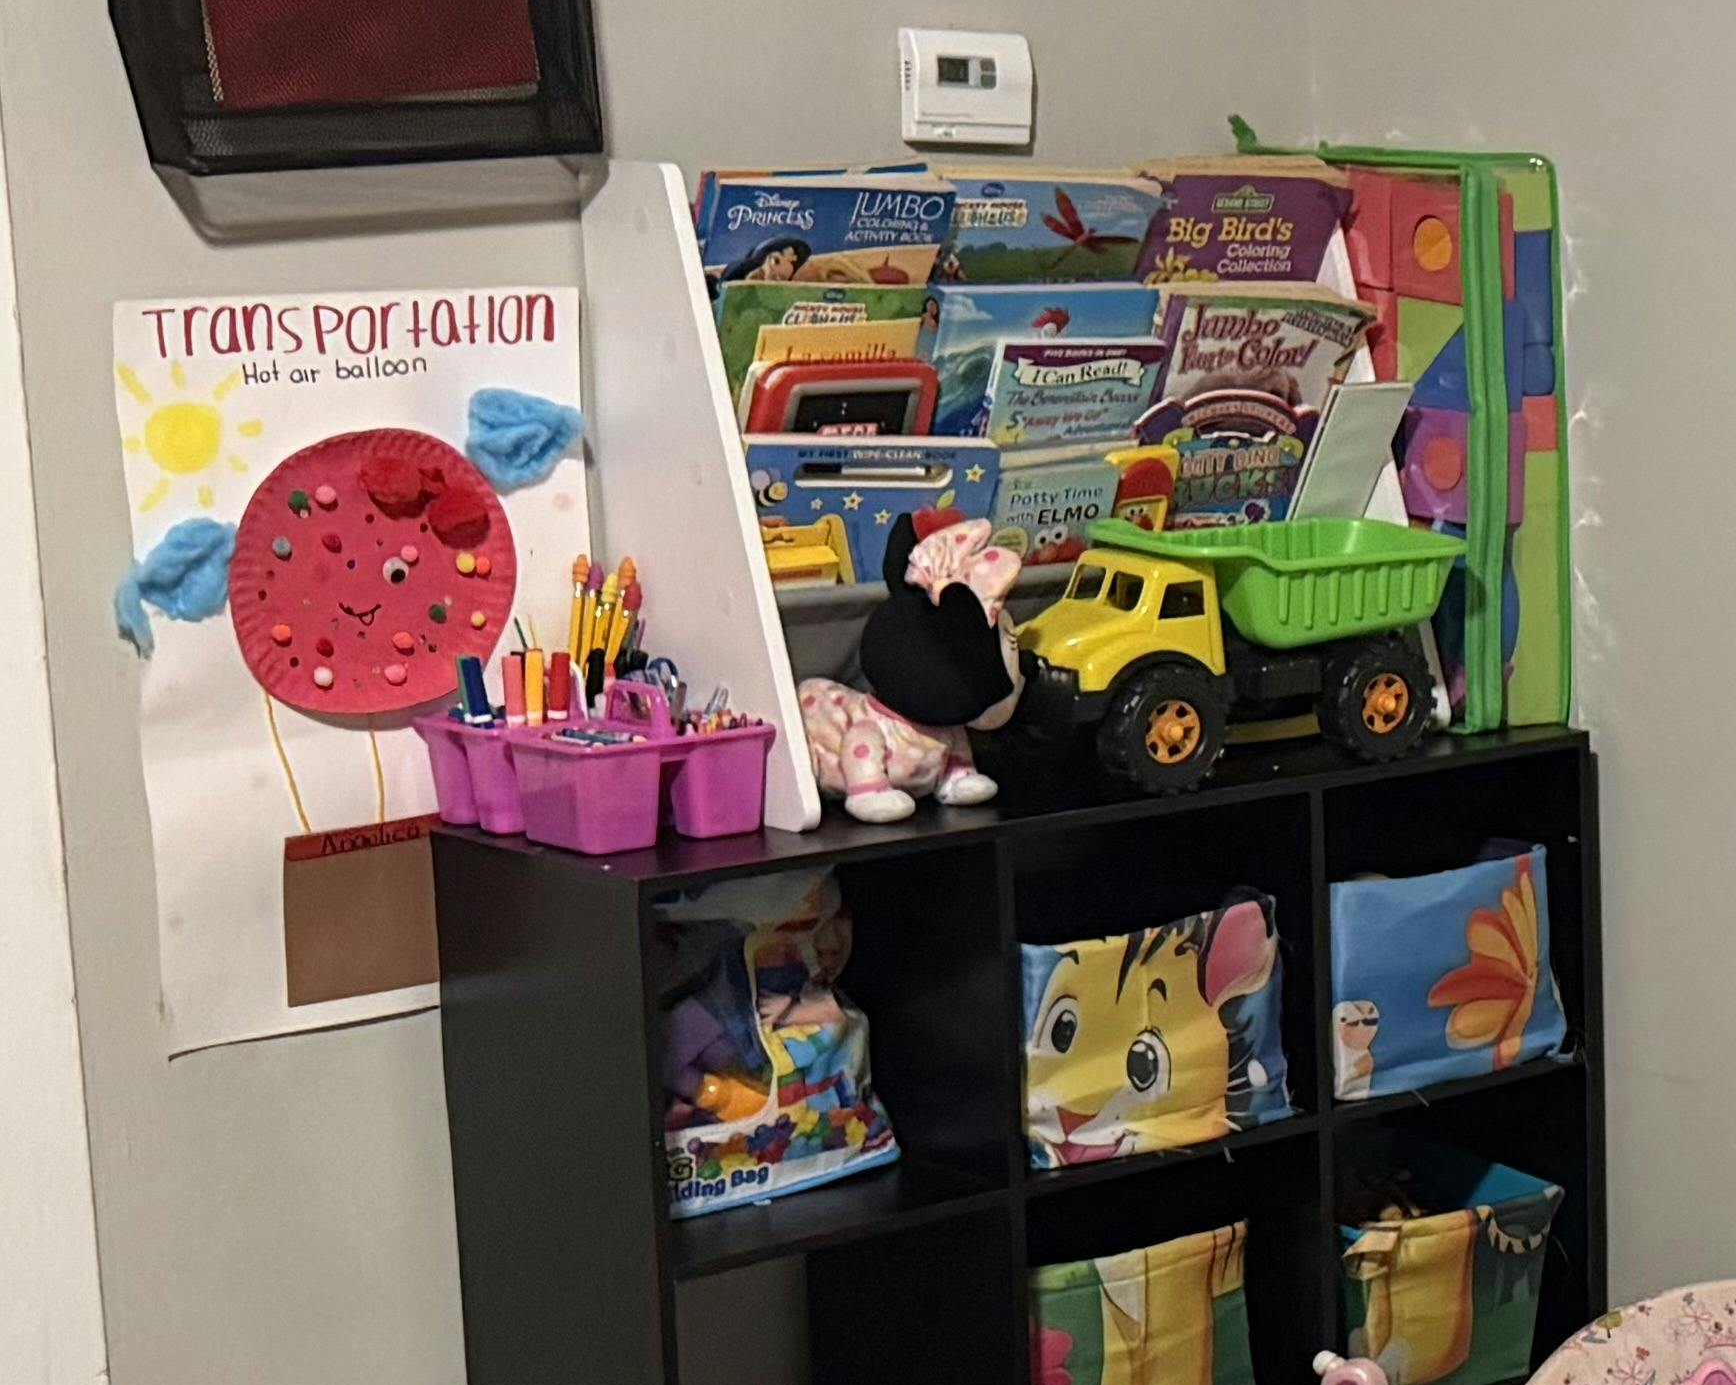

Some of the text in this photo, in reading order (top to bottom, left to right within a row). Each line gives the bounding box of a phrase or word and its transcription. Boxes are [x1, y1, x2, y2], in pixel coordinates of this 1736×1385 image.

[755, 191, 799, 208] Disney
[851, 192, 945, 224] JUMBO
[857, 218, 919, 232] COLORING
[1166, 217, 1294, 248] Big Bird's
[845, 231, 933, 243] ACTIVITY BOOK
[1227, 244, 1291, 260] Coloring
[1217, 259, 1291, 273] Collection
[1182, 304, 1280, 342] Jumbo
[242, 357, 427, 385] Hot air balloon
[1032, 362, 1127, 384] I Can Read!
[853, 449, 922, 459] WIPE-CLEAN
[1010, 486, 1103, 507] Potty Time
[1037, 503, 1100, 525] ELMO
[731, 1165, 769, 1187] Bag
